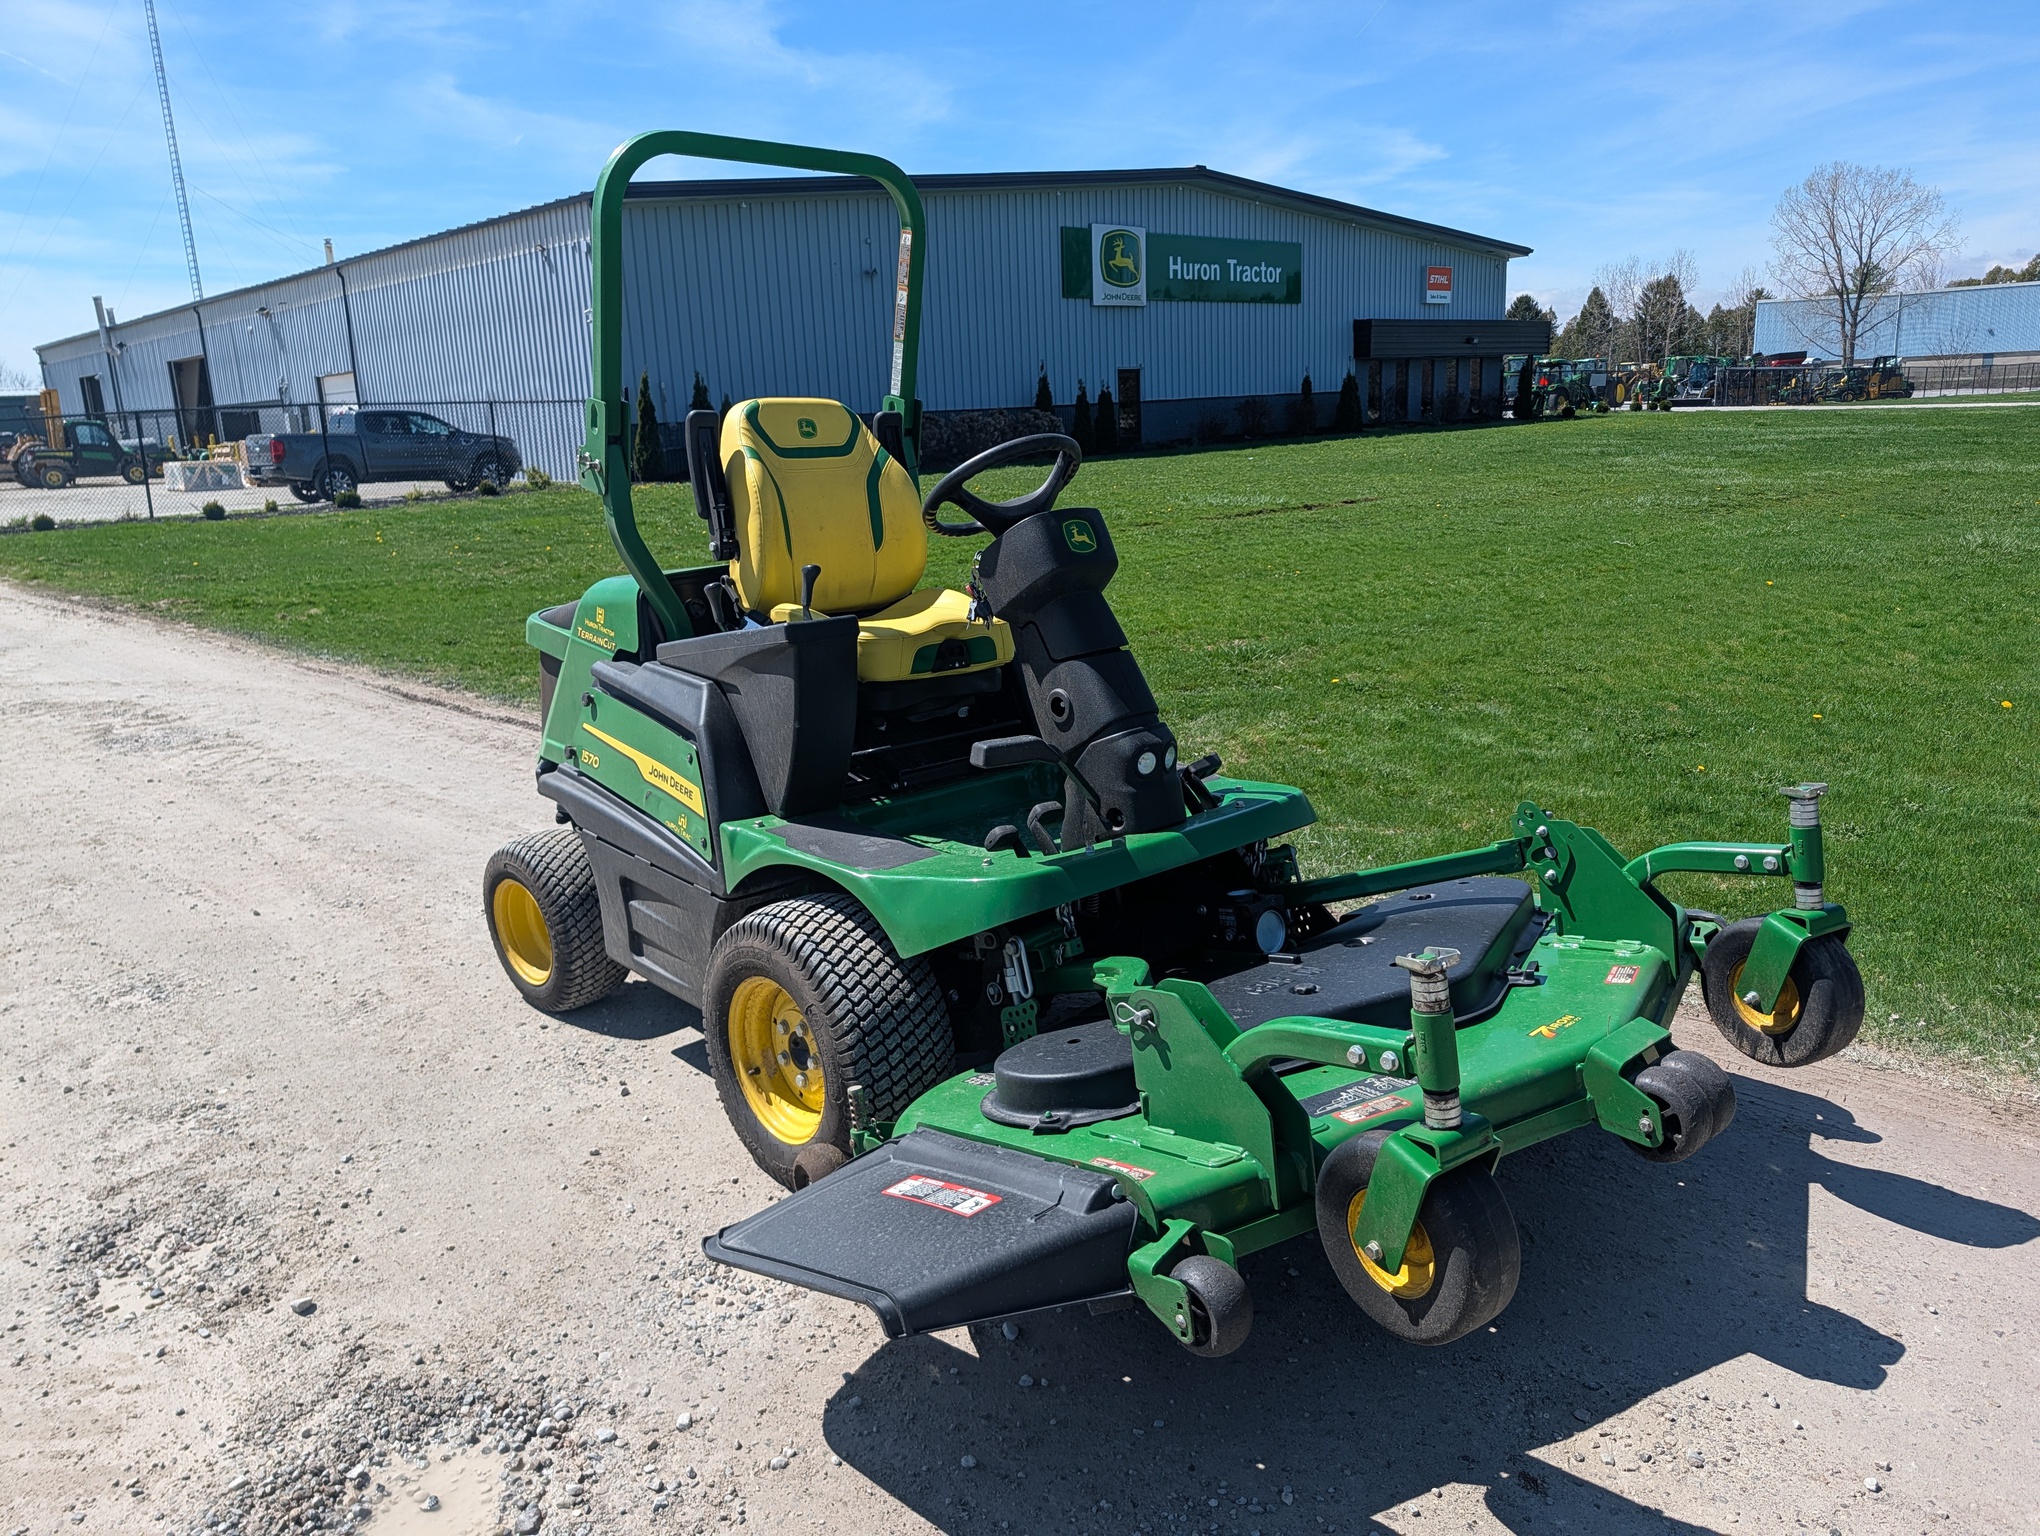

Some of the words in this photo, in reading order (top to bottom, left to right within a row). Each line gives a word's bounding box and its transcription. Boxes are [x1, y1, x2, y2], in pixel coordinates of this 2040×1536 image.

[1169, 255, 1220, 281] Huron
[1227, 258, 1282, 283] Tractor
[1429, 274, 1449, 284] STIHL
[1102, 292, 1121, 300] JOHN
[1121, 293, 1142, 301] DEERE
[581, 749, 600, 769] 1570
[649, 765, 668, 785] JOHN
[670, 777, 694, 800] DEERE
